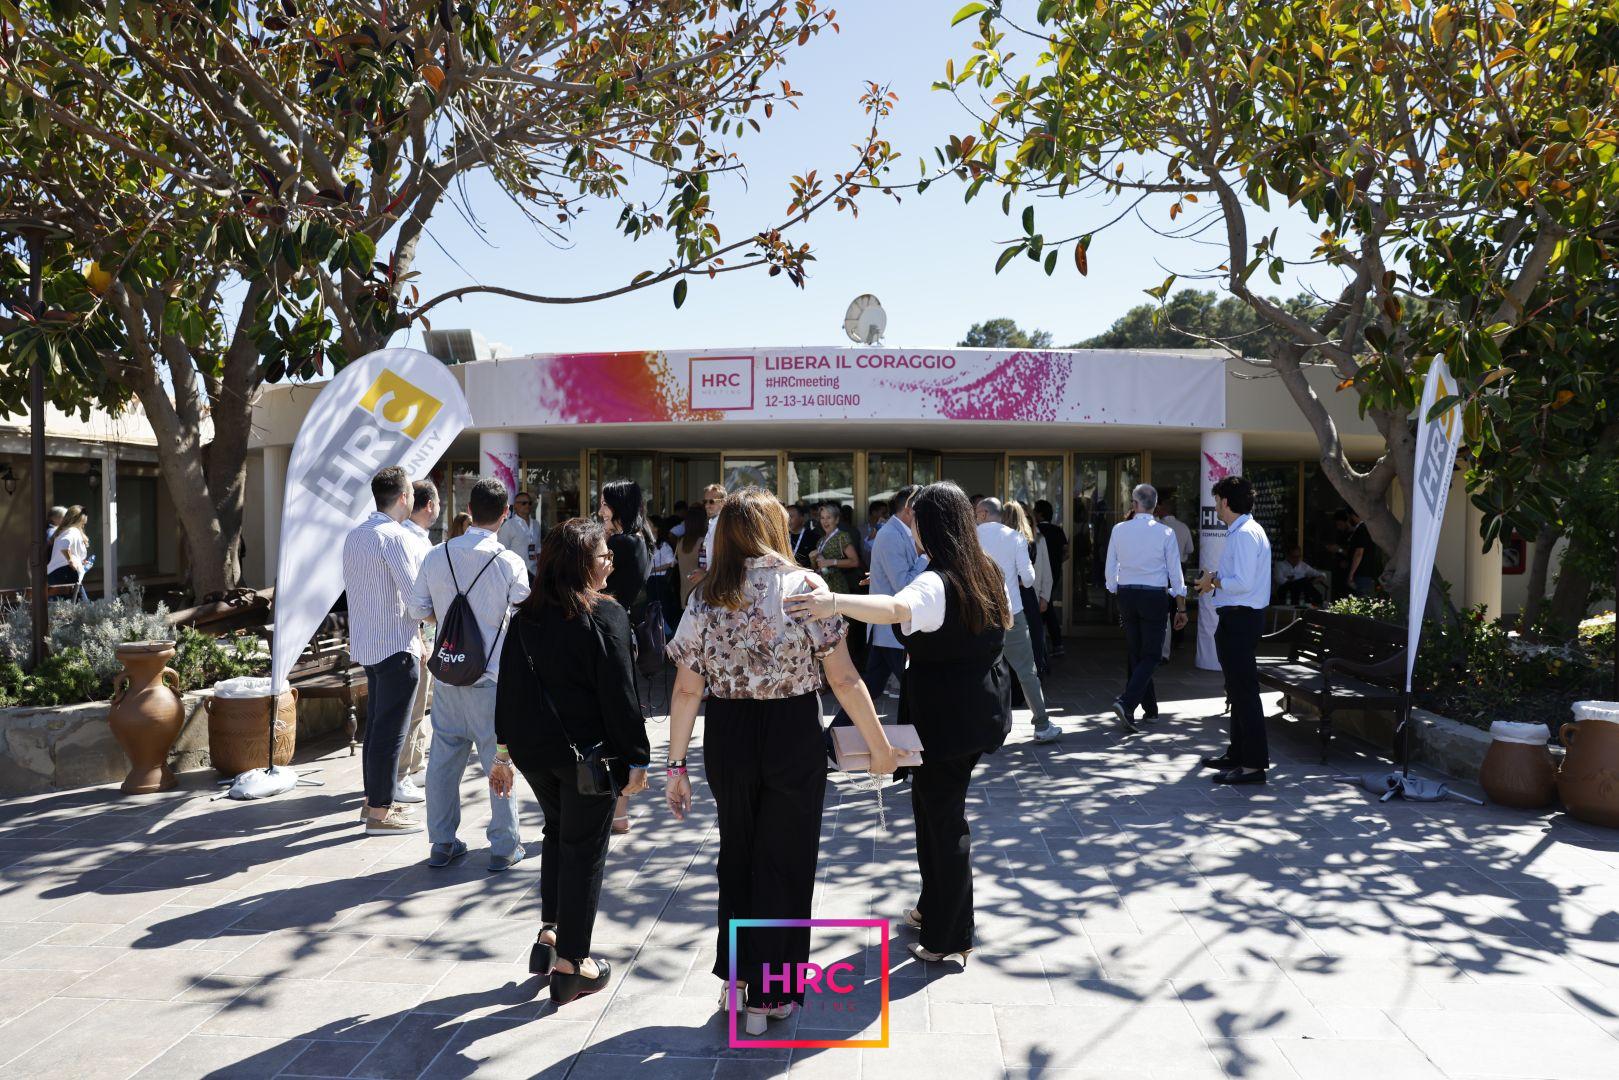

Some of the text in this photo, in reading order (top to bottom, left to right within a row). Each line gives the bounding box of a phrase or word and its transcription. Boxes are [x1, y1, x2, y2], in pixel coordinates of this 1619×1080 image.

[765, 354, 956, 371] LIBERA IL CORAGGIO
[701, 373, 741, 388] HRC
[765, 375, 840, 390] #HRCmeeting
[765, 394, 860, 408] 12-13-14 GIUGNO
[316, 390, 419, 506] HRC
